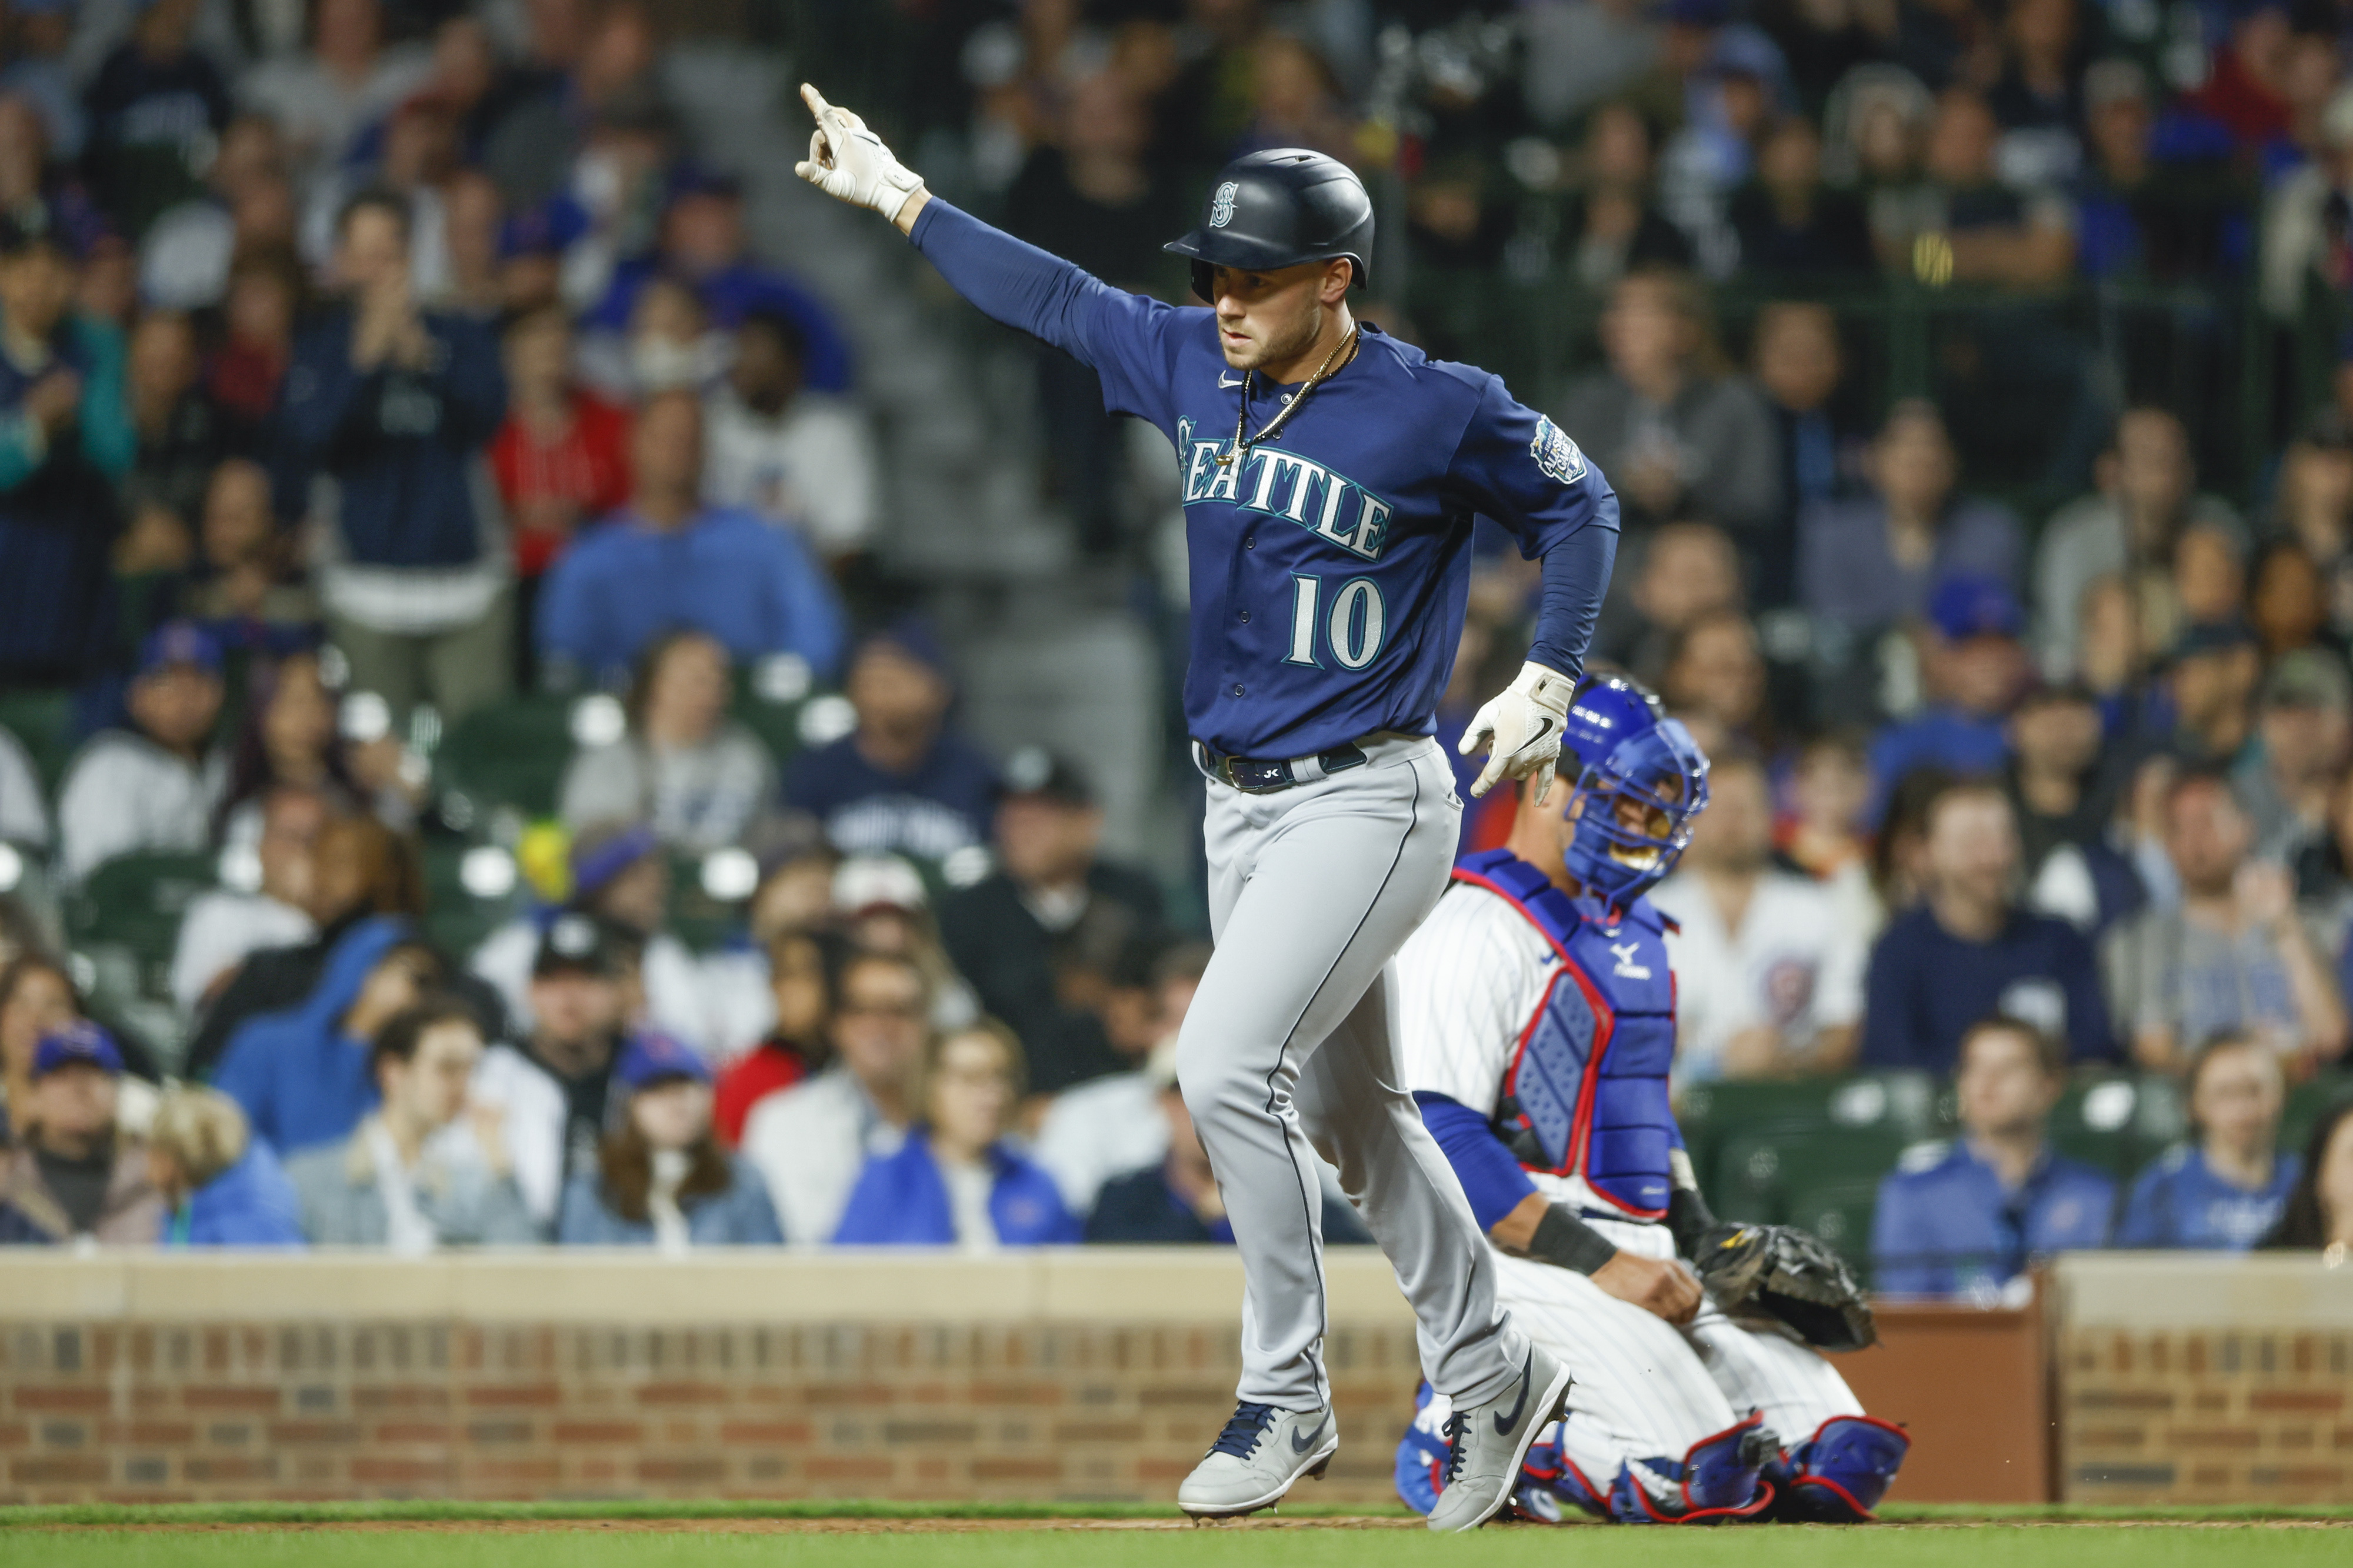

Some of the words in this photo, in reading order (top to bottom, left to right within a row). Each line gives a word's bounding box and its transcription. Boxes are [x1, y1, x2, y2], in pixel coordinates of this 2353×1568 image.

[1209, 181, 1238, 228] S
[1557, 440, 1571, 471] GAME
[1177, 415, 1394, 563] SEATTLE
[1281, 571, 1387, 670] 10
[1264, 768, 1279, 779] JK
